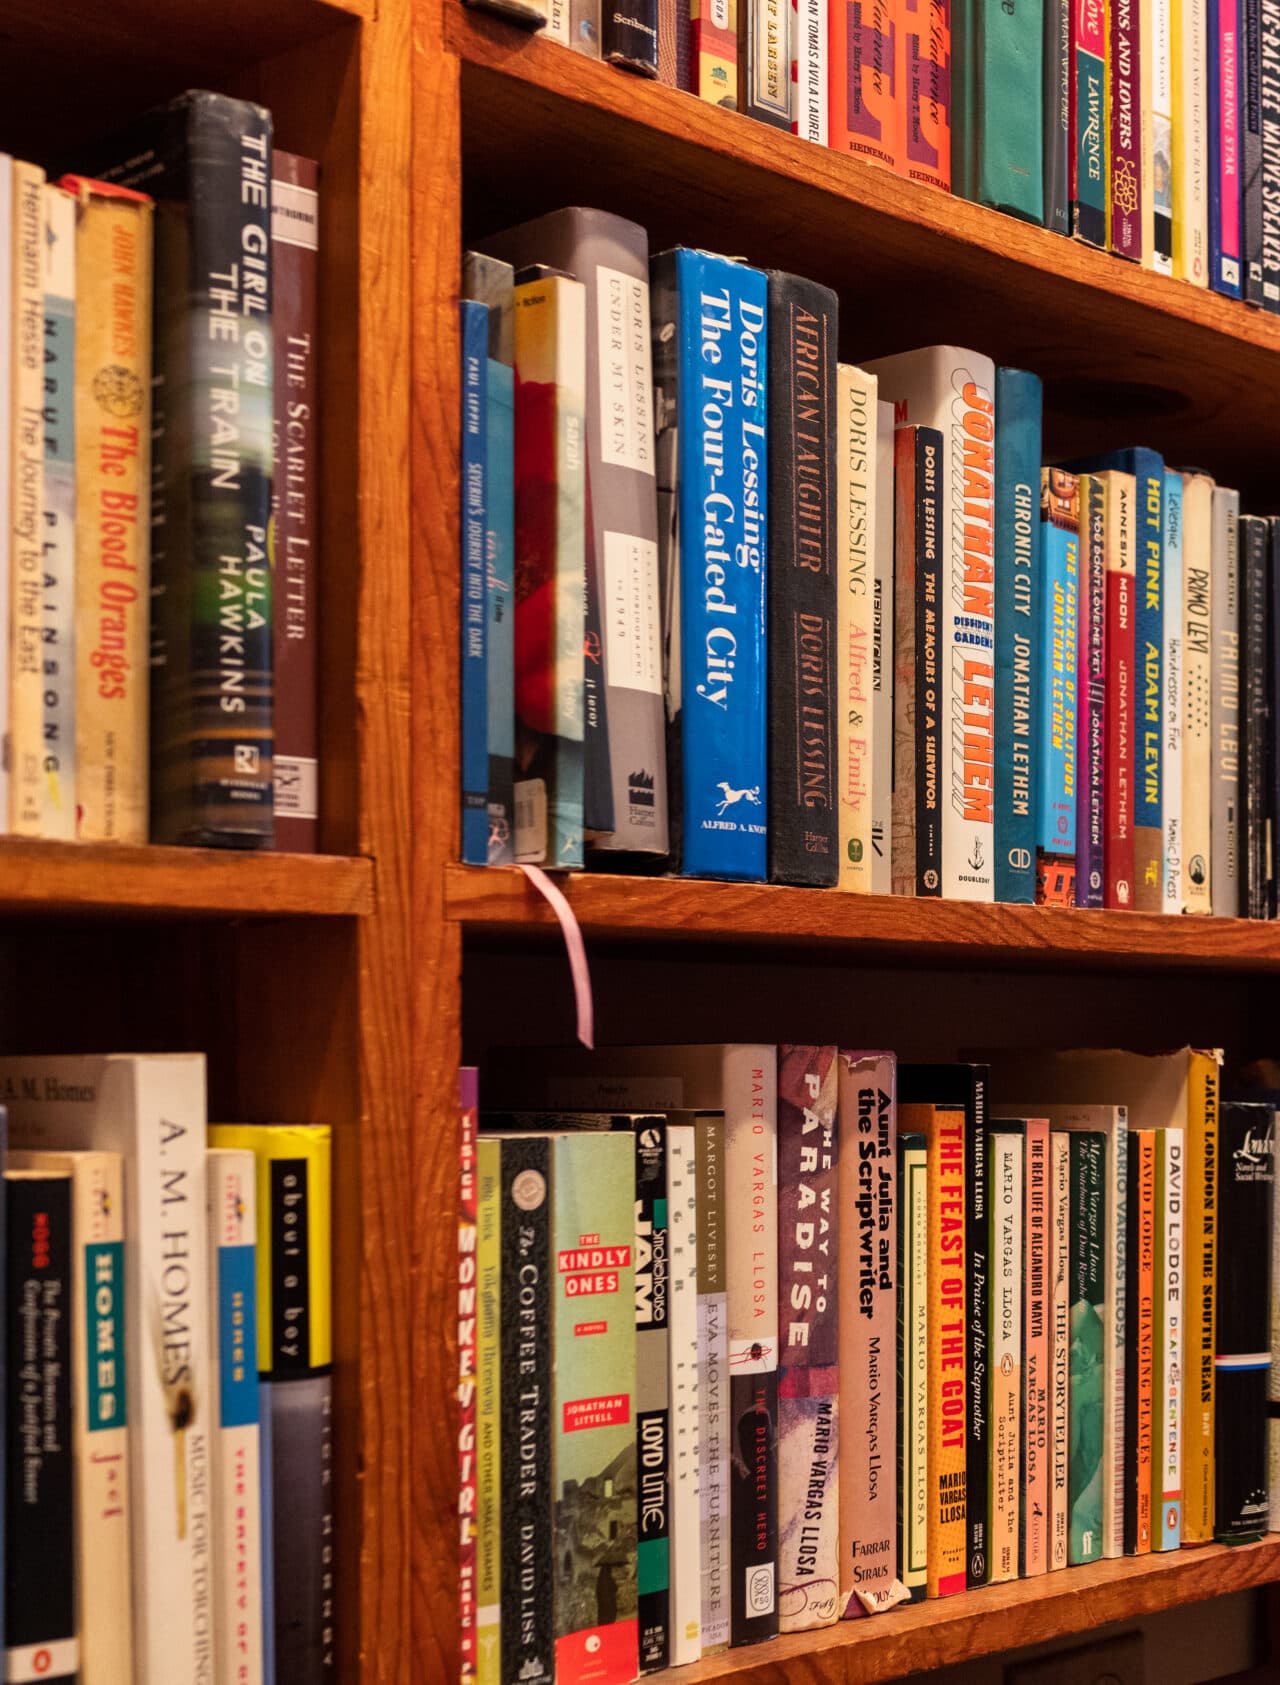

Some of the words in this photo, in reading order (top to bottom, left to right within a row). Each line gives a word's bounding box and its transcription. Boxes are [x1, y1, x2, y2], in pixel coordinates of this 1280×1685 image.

[767, 15, 778, 98] LARSEN
[1118, 33, 1132, 76] AND
[1223, 31, 1234, 128] WANDERING
[912, 77, 920, 103] Harry
[1118, 79, 1132, 150] LOVERS
[911, 117, 920, 143] Moore
[1084, 75, 1100, 180] LAWRENCE
[1224, 135, 1236, 175] STAR
[240, 134, 267, 208] THE
[208, 264, 239, 341] THE
[240, 226, 268, 316] GIRL
[610, 279, 622, 351] UNDER
[631, 284, 644, 353] DORIS
[700, 287, 732, 366] The
[43, 318, 58, 454] HARUF
[243, 332, 269, 386] ON
[287, 333, 311, 387] THE
[612, 362, 623, 392] MY
[738, 298, 765, 407] Doris
[796, 305, 820, 423] AFRICAN
[210, 366, 240, 490] TRAIN
[613, 403, 625, 455] SKIN
[633, 363, 648, 461] LESSING
[848, 388, 867, 472] DORIS
[100, 425, 138, 476] The
[286, 401, 310, 527] SCARLET
[924, 445, 936, 493] DORIS
[100, 490, 138, 570] Blood
[702, 375, 738, 615] Four-Gated
[735, 419, 765, 574] Lessing
[798, 430, 824, 573] LAUGHTER
[923, 498, 936, 560] LESSING
[1014, 483, 1032, 569] CHRONIC
[1119, 489, 1128, 568] AMNESIA
[1146, 478, 1161, 532] HOT
[848, 482, 867, 597] LESSING
[1066, 541, 1077, 576] THE
[244, 525, 268, 630] PAULA
[285, 535, 310, 641] LETTER
[924, 572, 936, 603] THE
[1014, 574, 1032, 616] CITY
[1119, 577, 1128, 630] MOON
[1145, 541, 1161, 611] PINK
[43, 511, 59, 773] PLAINSONG
[90, 578, 137, 699] Oranges
[217, 554, 246, 713] HAWKINS
[925, 609, 936, 684] MEMOIRS
[1052, 580, 1064, 673] JONATHAN
[1065, 581, 1076, 673] FORTRESS
[696, 626, 738, 712] City
[925, 692, 936, 713] OF
[1013, 634, 1031, 737] JONATHAN
[1065, 679, 1075, 703] OF
[1144, 642, 1160, 722] ADAM
[925, 717, 936, 729] A
[1051, 677, 1063, 750] LETHEM
[1118, 660, 1128, 760] JONATHAN
[925, 735, 937, 810] SURVIVOR
[1012, 743, 1030, 816] LETHEM
[1063, 708, 1075, 797] SOLITUDE
[1091, 710, 1101, 786] JONATHAN
[1144, 733, 1158, 804] LEVIN
[1091, 787, 1101, 845] LETHEM
[1118, 767, 1127, 840] LETHEM
[751, 1067, 764, 1136] MARIO
[1204, 1074, 1216, 1124] JACK
[159, 1119, 189, 1156] A.
[706, 1125, 717, 1201] MARGOT
[820, 1112, 834, 1171] THE
[940, 1125, 963, 1177] THE
[1056, 1144, 1070, 1191] Mario
[1203, 1131, 1216, 1211] LONDON
[160, 1169, 188, 1218] M.
[752, 1152, 765, 1234] VARGAS
[788, 1073, 822, 1347] PARADISE
[1003, 1152, 1014, 1205] MARIO
[1168, 1145, 1181, 1215] DAVID
[283, 1174, 303, 1256] about
[580, 1235, 599, 1246] THE
[706, 1210, 718, 1285] LIVESEY
[819, 1188, 832, 1257] WAY
[940, 1185, 963, 1267] FEAST
[1003, 1214, 1013, 1278] VARGAS
[1056, 1194, 1069, 1242] Vargas
[1203, 1216, 1214, 1235] IN
[284, 1275, 298, 1288] a
[558, 1248, 629, 1271] KINDLY
[566, 1276, 618, 1295] ONES
[752, 1251, 766, 1319] LLOSA
[1056, 1245, 1068, 1282] Llosa
[1167, 1222, 1181, 1303] LODGE
[1202, 1239, 1214, 1279] THE
[161, 1231, 192, 1386] HOMES
[706, 1302, 721, 1342] EVA
[816, 1275, 828, 1314] TO
[940, 1278, 964, 1311] OF
[1002, 1288, 1013, 1341] LLOSA
[1055, 1301, 1067, 1343] THE
[1201, 1285, 1214, 1351] SOUTH
[95, 1253, 116, 1420] HOMES
[232, 1292, 244, 1382] HOMES
[281, 1306, 305, 1357] boy
[941, 1318, 964, 1372] THE
[1168, 1316, 1178, 1359] DEAF
[707, 1353, 720, 1426] MOVES
[757, 1388, 768, 1417] THE
[941, 1379, 965, 1449] GOAT
[1007, 1391, 1016, 1422] Aunt
[1200, 1354, 1212, 1404] SEAS
[708, 1431, 720, 1476] THE
[1007, 1431, 1016, 1470] Julia
[1055, 1348, 1066, 1490] STORYTELLER
[1167, 1386, 1178, 1476] SENTENCE
[755, 1425, 768, 1502] DISCREET
[997, 1416, 1006, 1513] Scriptwriter
[1007, 1475, 1016, 1503] and
[708, 1482, 722, 1611] FURNITURE
[755, 1512, 768, 1551] HERO
[1007, 1508, 1016, 1534] the
